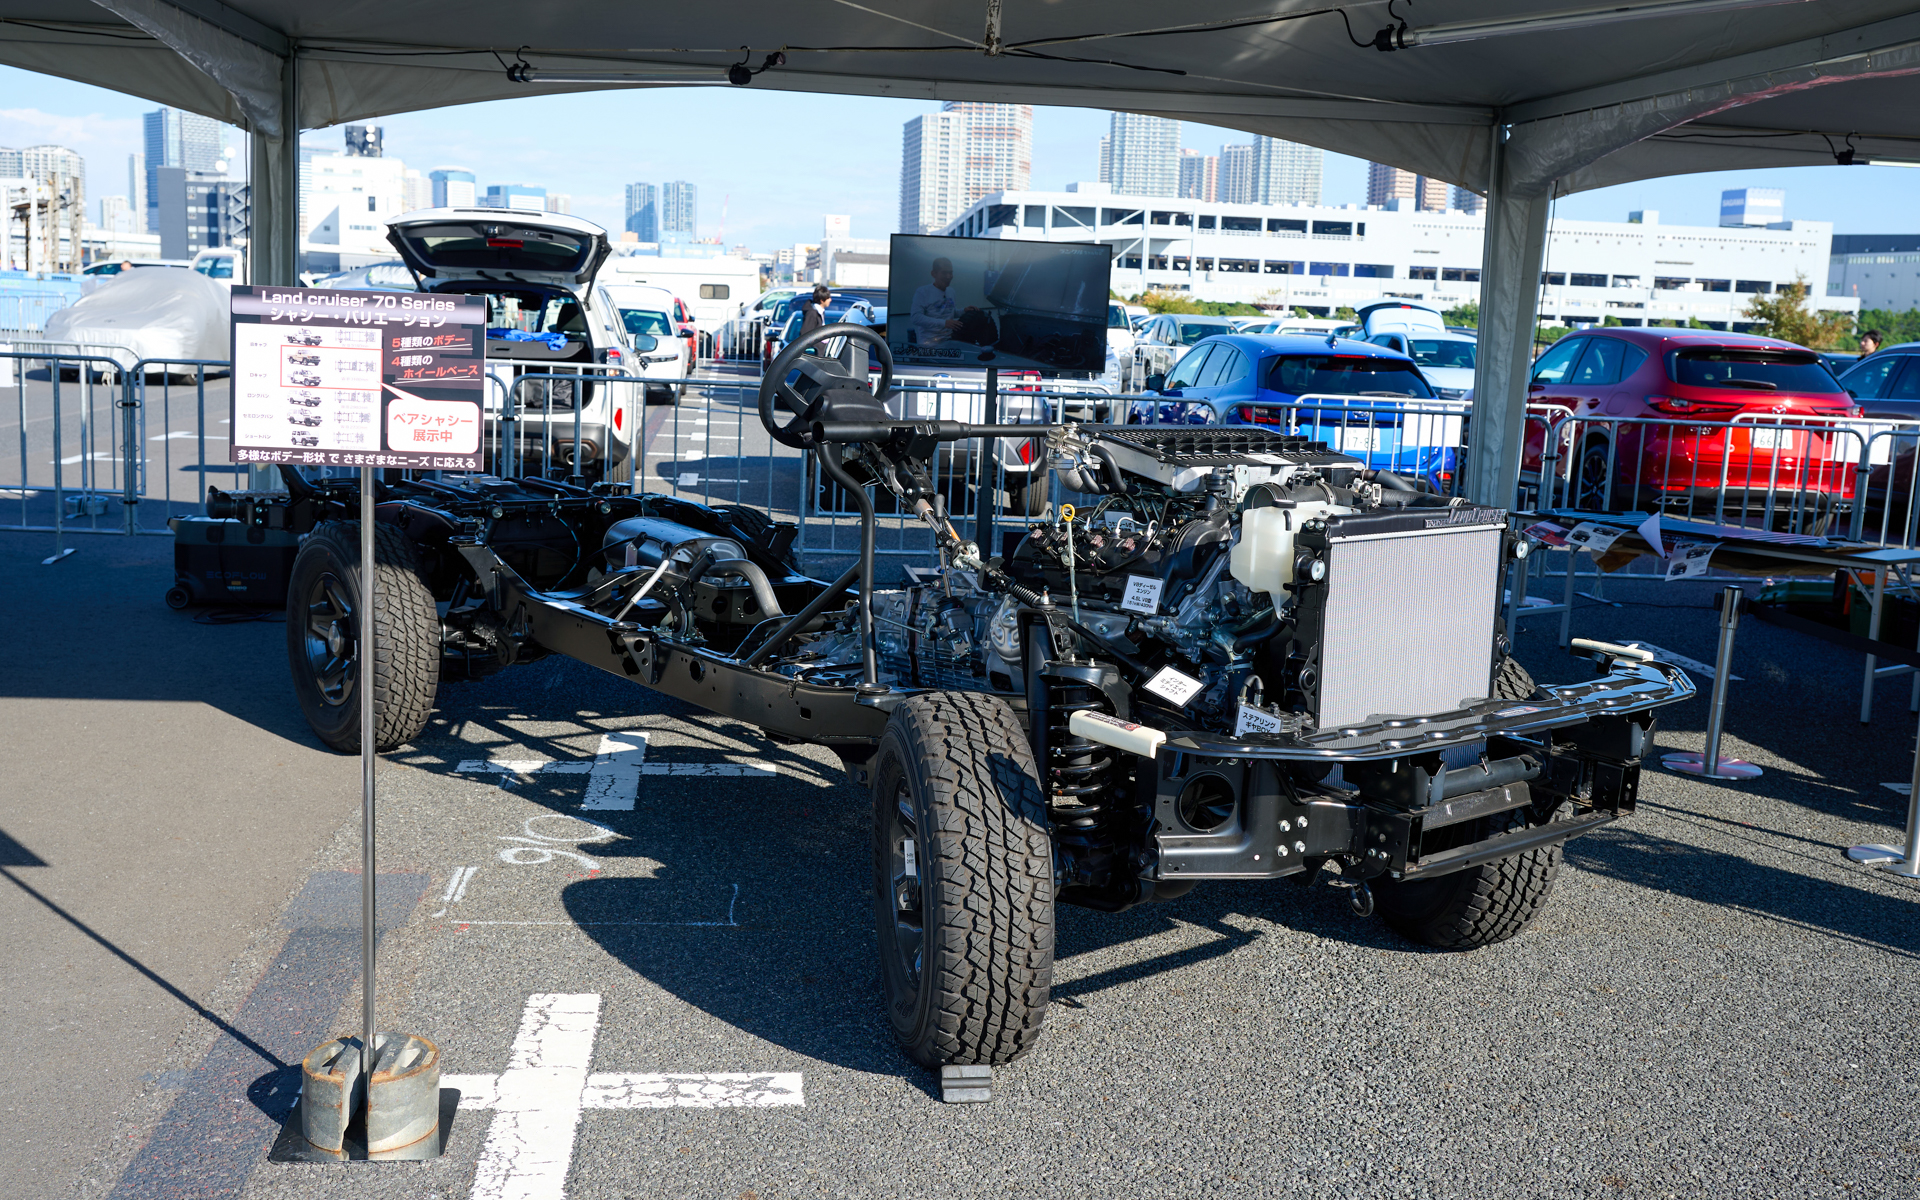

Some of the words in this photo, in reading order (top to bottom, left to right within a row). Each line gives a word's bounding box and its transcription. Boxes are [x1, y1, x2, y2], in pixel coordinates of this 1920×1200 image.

[262, 290, 303, 305] Land
[307, 293, 368, 308] cruiser
[372, 295, 397, 309] 70
[401, 297, 456, 312] Series
[270, 307, 447, 328] シャシー・バリエーション
[392, 334, 466, 348] 5種類のボデー
[391, 355, 433, 367] 4種類の
[403, 365, 478, 378] ホイールベース
[393, 412, 473, 427] ベアシャシー
[413, 428, 453, 442] 展示中
[237, 449, 326, 464] 多様なボデー形状
[328, 452, 340, 464] で
[343, 453, 430, 467] さまざまなニーズ
[433, 456, 477, 469] に応える
[206, 570, 267, 580] ECOFLOW
[1242, 711, 1277, 729] ステアリング
